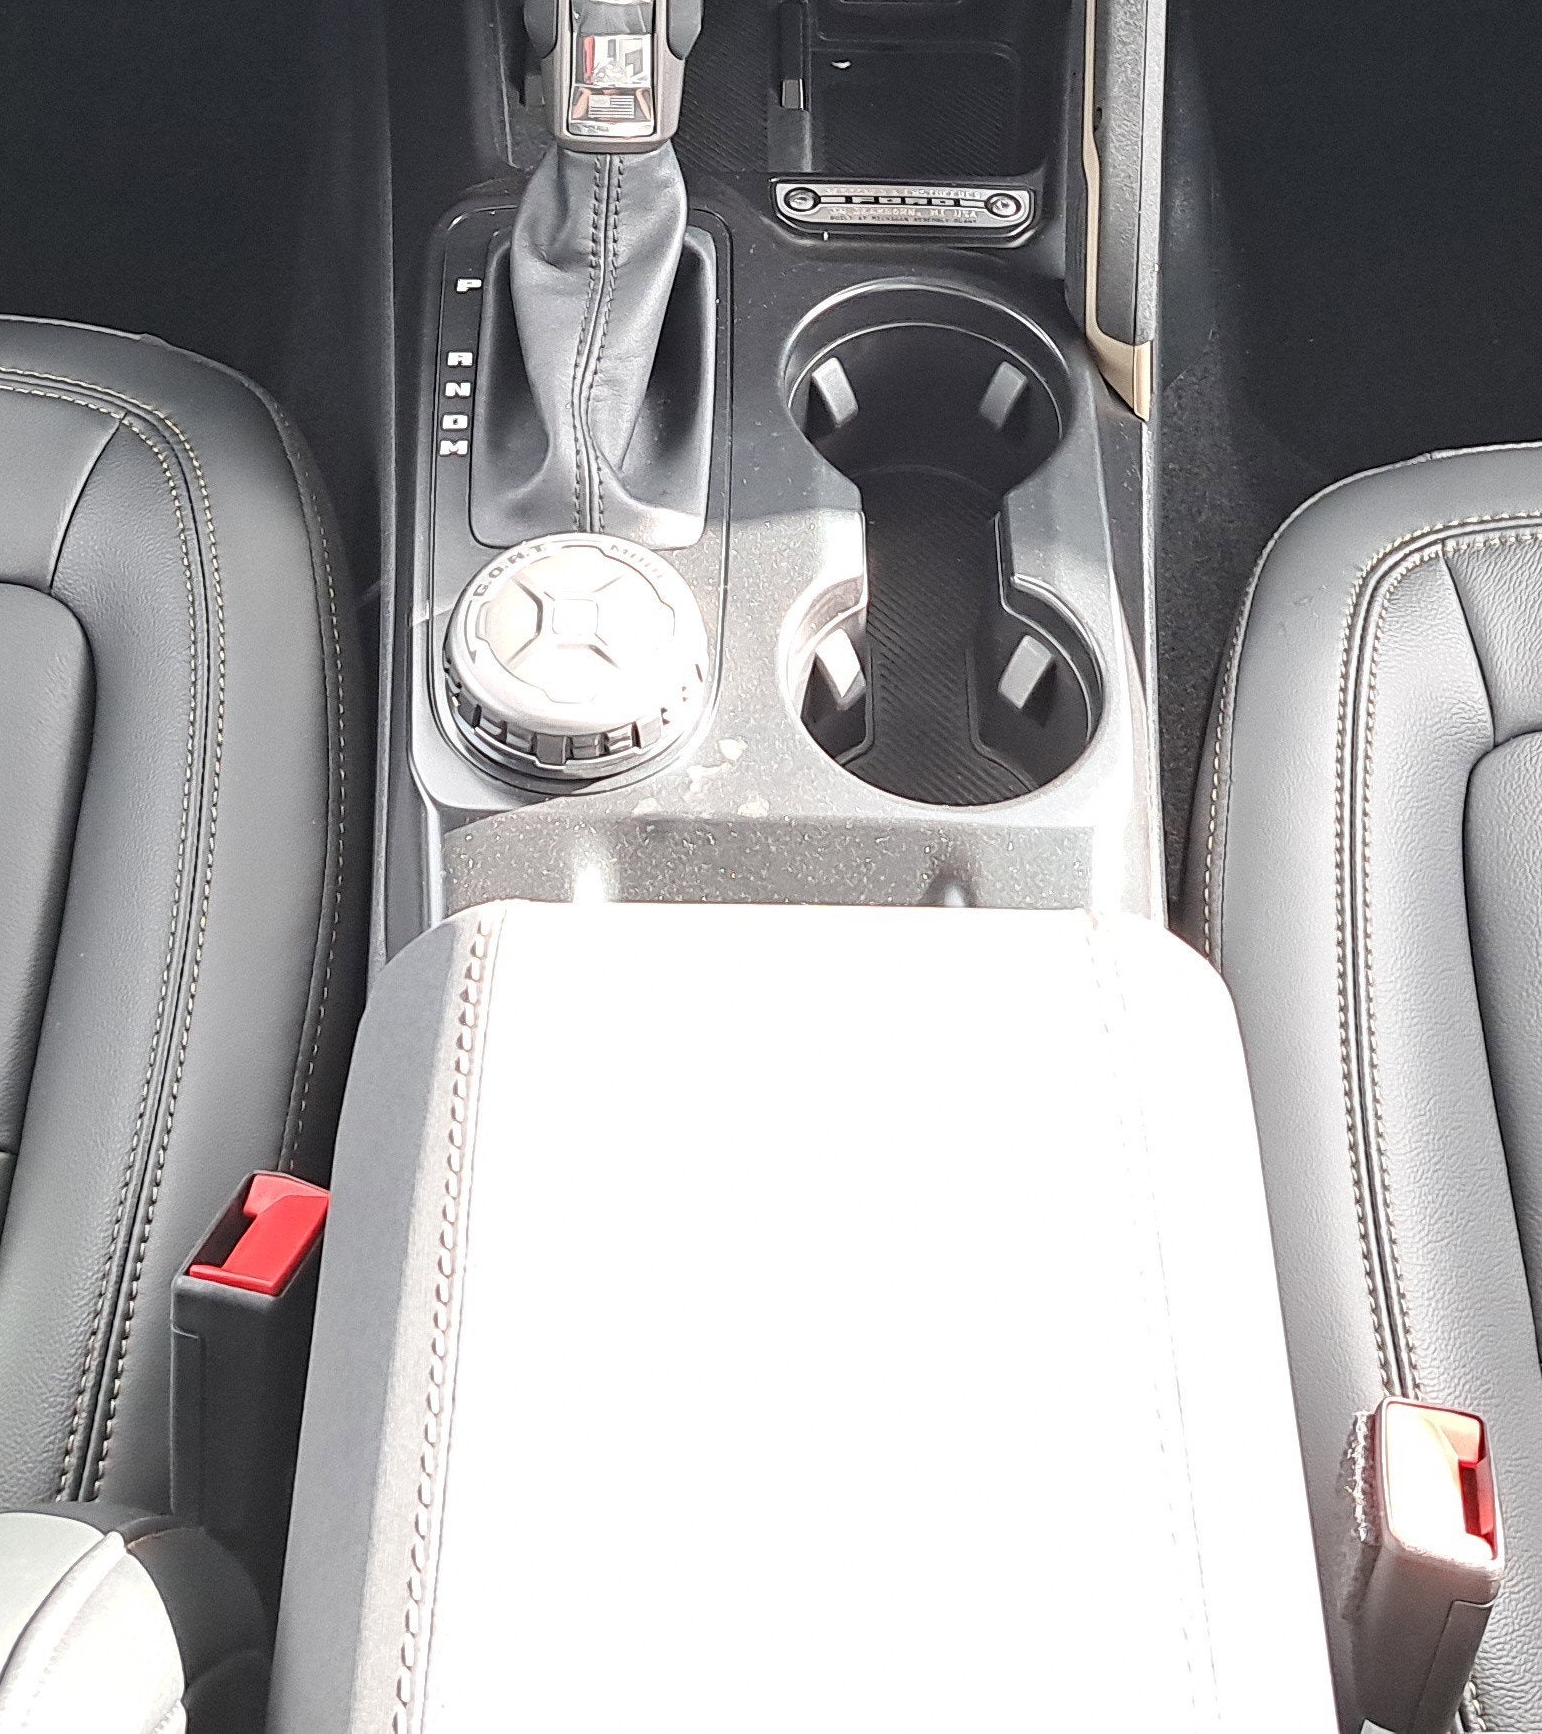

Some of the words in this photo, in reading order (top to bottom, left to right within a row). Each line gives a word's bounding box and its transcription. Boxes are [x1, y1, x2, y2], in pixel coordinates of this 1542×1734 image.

[456, 279, 482, 292] P
[445, 382, 471, 397] N
[439, 440, 469, 455] M
